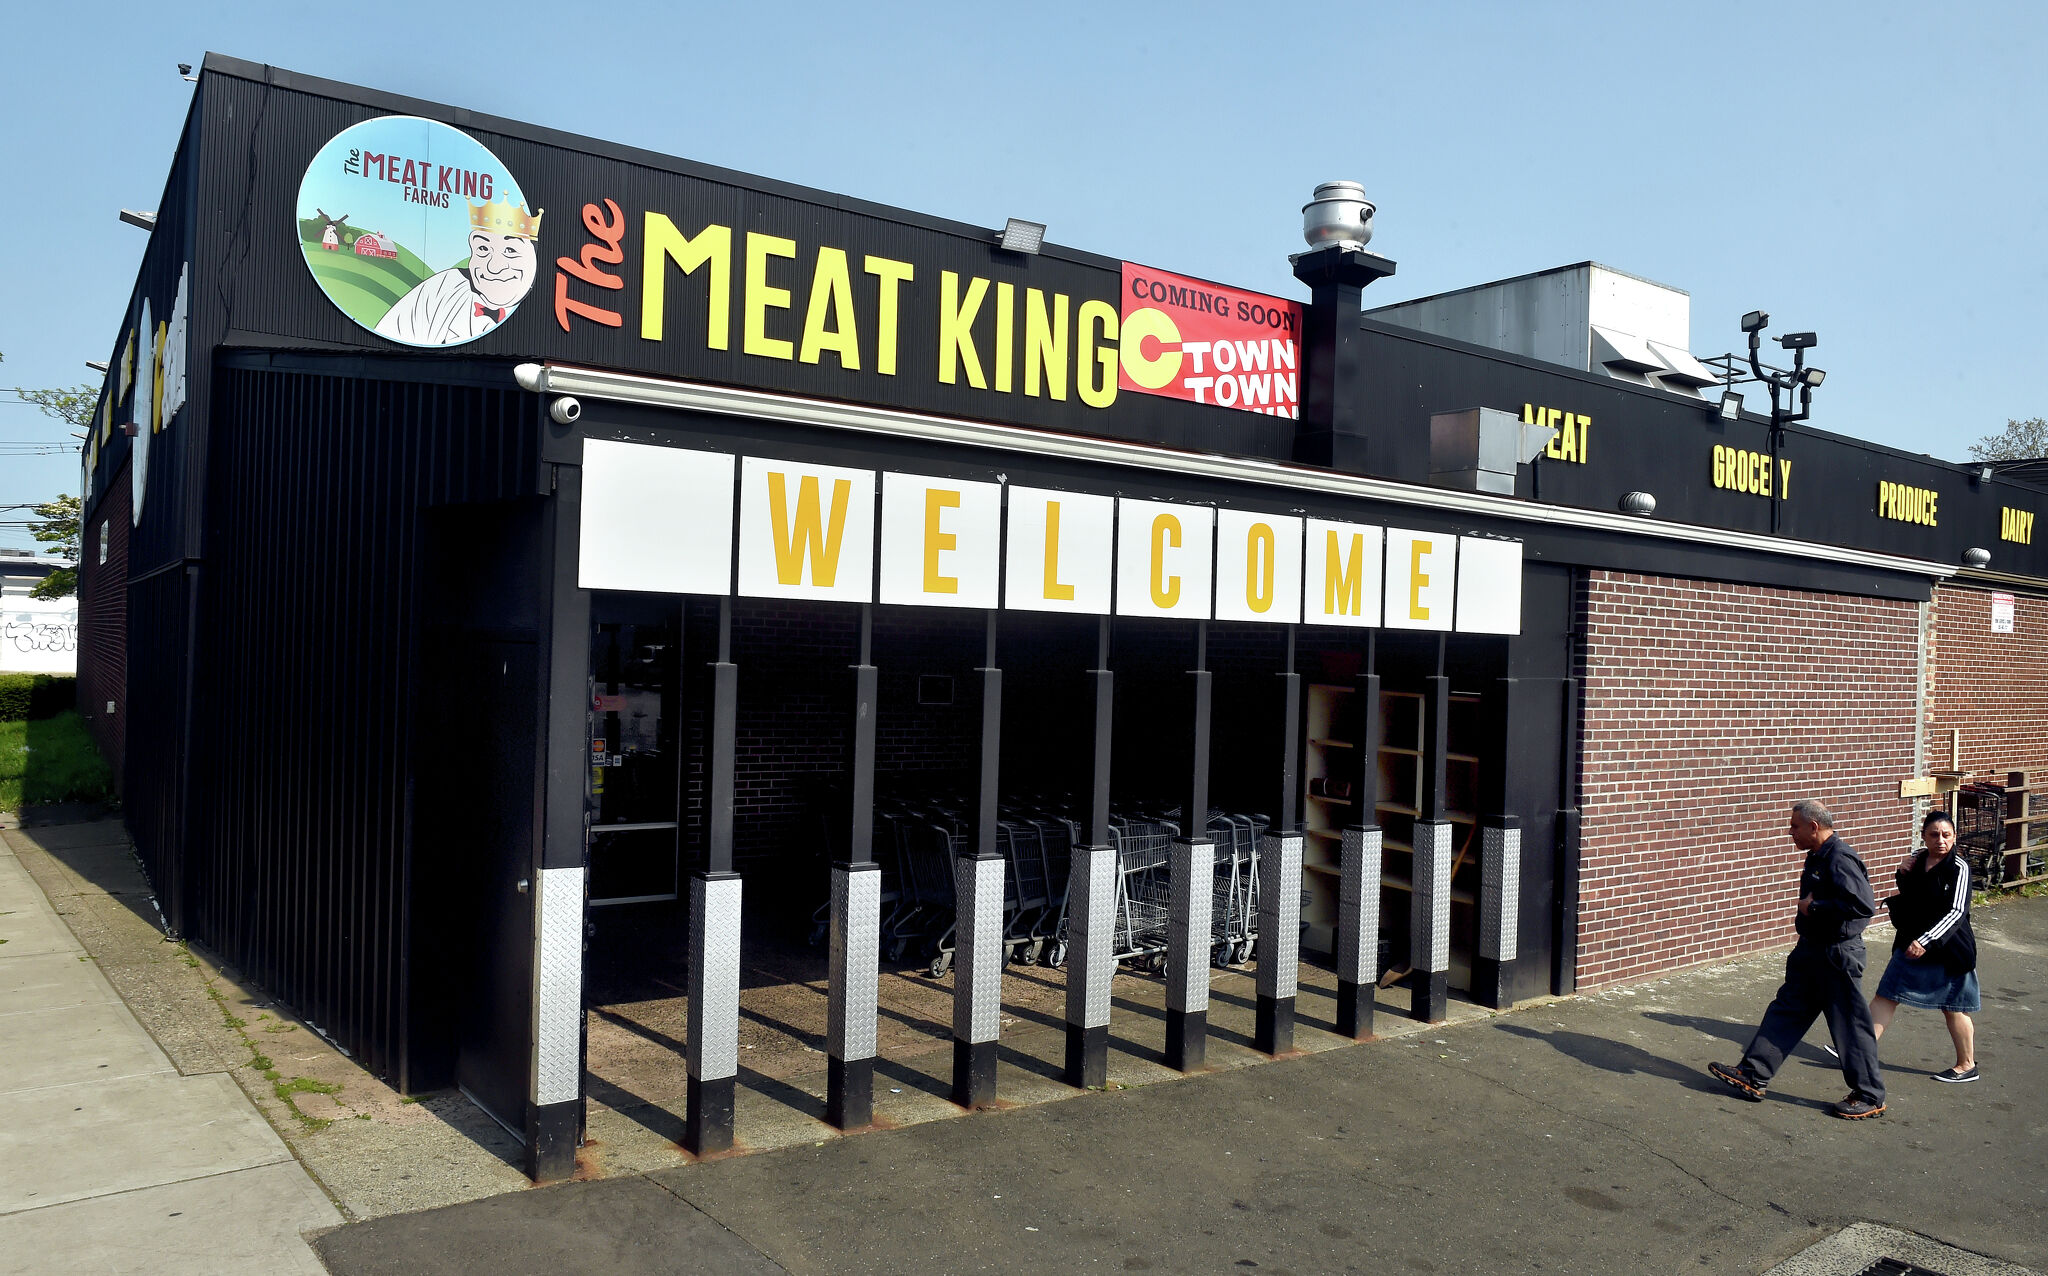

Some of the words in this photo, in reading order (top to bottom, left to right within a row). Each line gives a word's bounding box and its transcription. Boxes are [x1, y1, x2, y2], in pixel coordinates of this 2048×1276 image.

[344, 148, 360, 175] The
[363, 150, 432, 189] MEAT
[438, 165, 493, 201] KING
[404, 186, 449, 209] FARMS
[555, 198, 625, 332] The
[641, 211, 914, 376] MEAT
[938, 270, 1119, 409] KING
[1132, 277, 1230, 317] COMING
[1237, 301, 1296, 332] SOON
[1182, 338, 1296, 374] TOWN
[1184, 372, 1298, 407] TOWN
[1713, 444, 1792, 500] GROCEY
[1879, 480, 1938, 527] PRODUCE
[2001, 506, 2035, 545] DAIRY
[767, 471, 1433, 620] WELCOME
